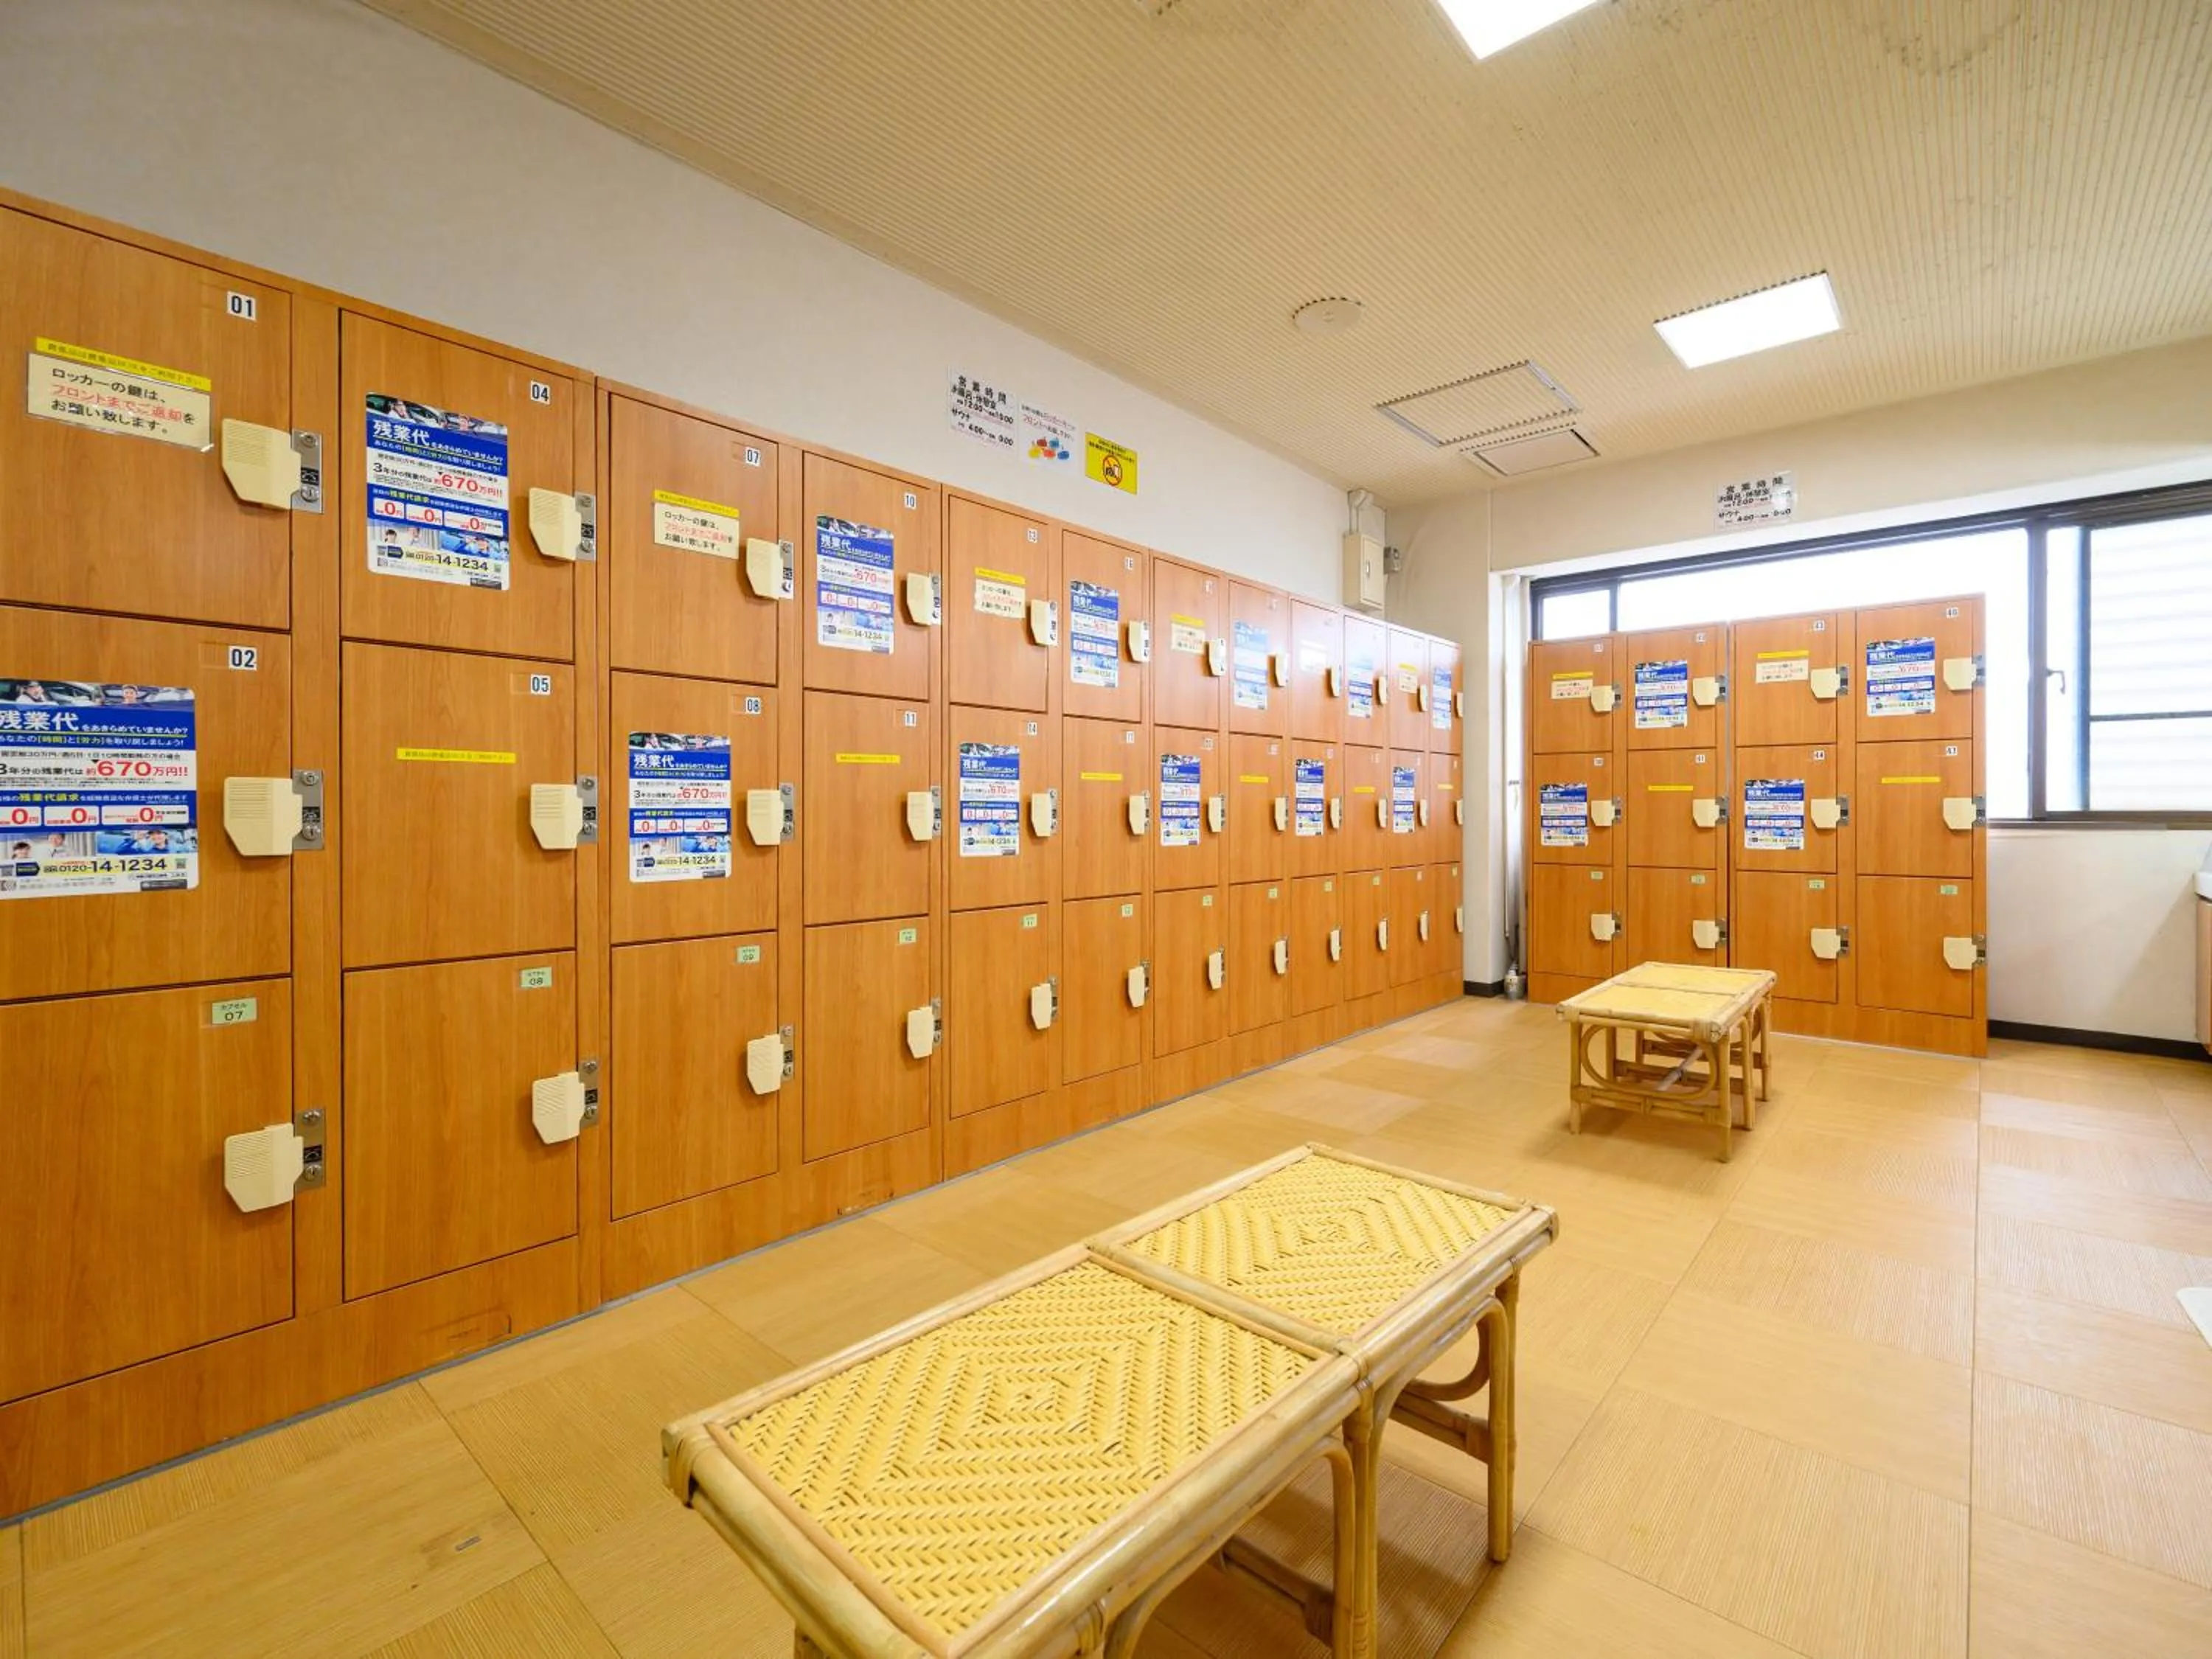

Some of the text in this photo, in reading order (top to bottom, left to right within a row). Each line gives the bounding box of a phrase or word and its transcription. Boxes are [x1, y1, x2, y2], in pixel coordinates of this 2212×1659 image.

[231, 296, 252, 317] 01
[532, 384, 549, 401] 04
[747, 449, 759, 463] 07
[231, 649, 254, 667] 02
[532, 677, 549, 692] 05
[747, 698, 759, 712] 08
[59, 858, 167, 873] 0120-14-1234
[530, 977, 543, 985] 08
[224, 1010, 243, 1020] 07
